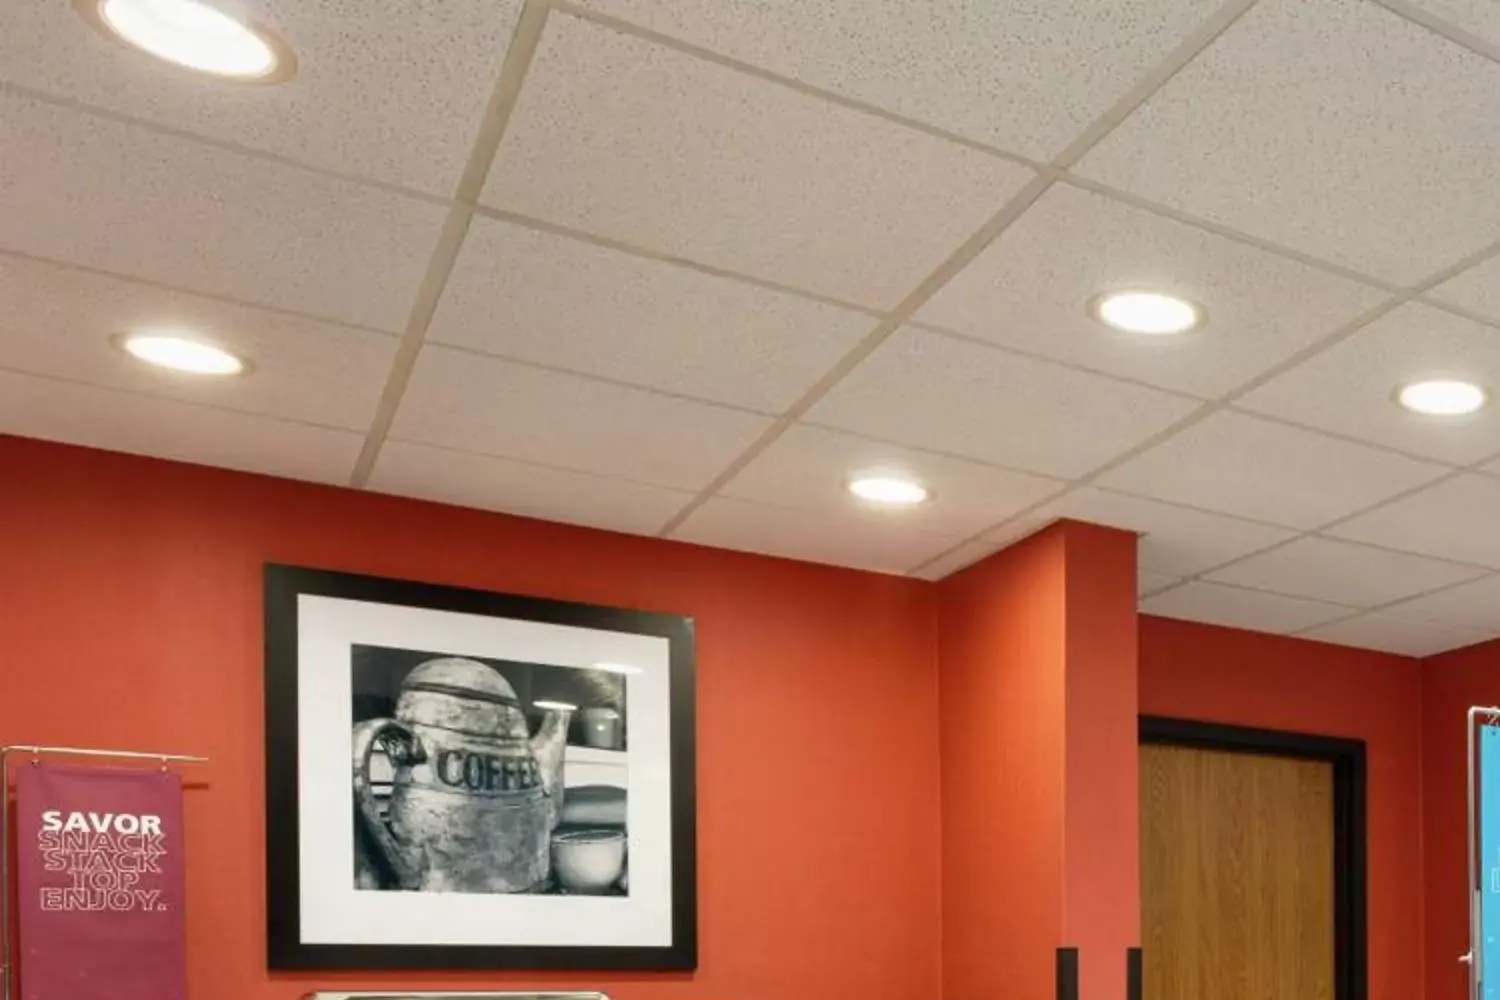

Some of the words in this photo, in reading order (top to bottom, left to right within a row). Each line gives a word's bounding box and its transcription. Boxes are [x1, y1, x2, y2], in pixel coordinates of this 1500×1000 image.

[437, 748, 541, 790] COFFEE
[41, 810, 162, 834] SAVOR
[37, 829, 167, 855] SNACK
[43, 850, 162, 873] STACK
[67, 869, 139, 891] TOP
